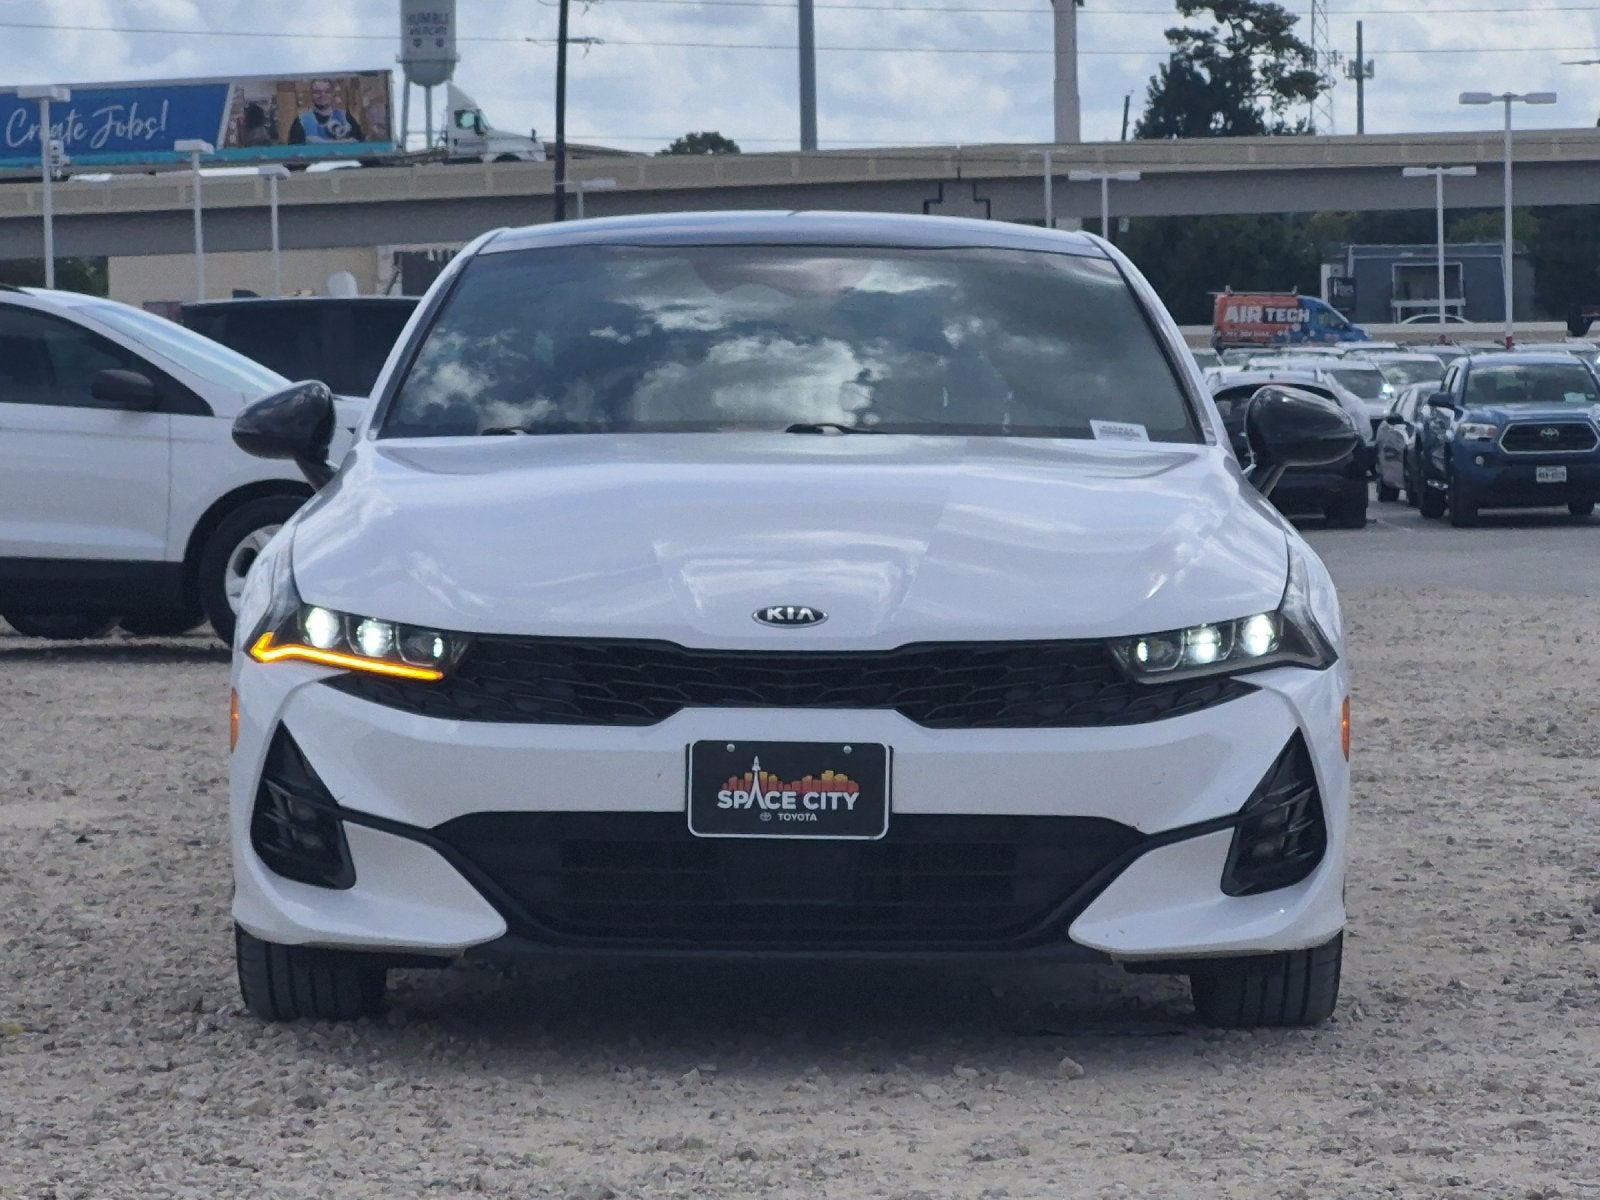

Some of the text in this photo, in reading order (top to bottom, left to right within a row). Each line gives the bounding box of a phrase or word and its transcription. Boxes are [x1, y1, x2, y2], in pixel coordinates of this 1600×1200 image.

[6, 99, 169, 149] Crate Jobs!
[1224, 305, 1310, 323] AIR TECH
[767, 606, 815, 620] KIA
[717, 781, 860, 811] SPACE CITY
[777, 813, 817, 822] TOYOTA
